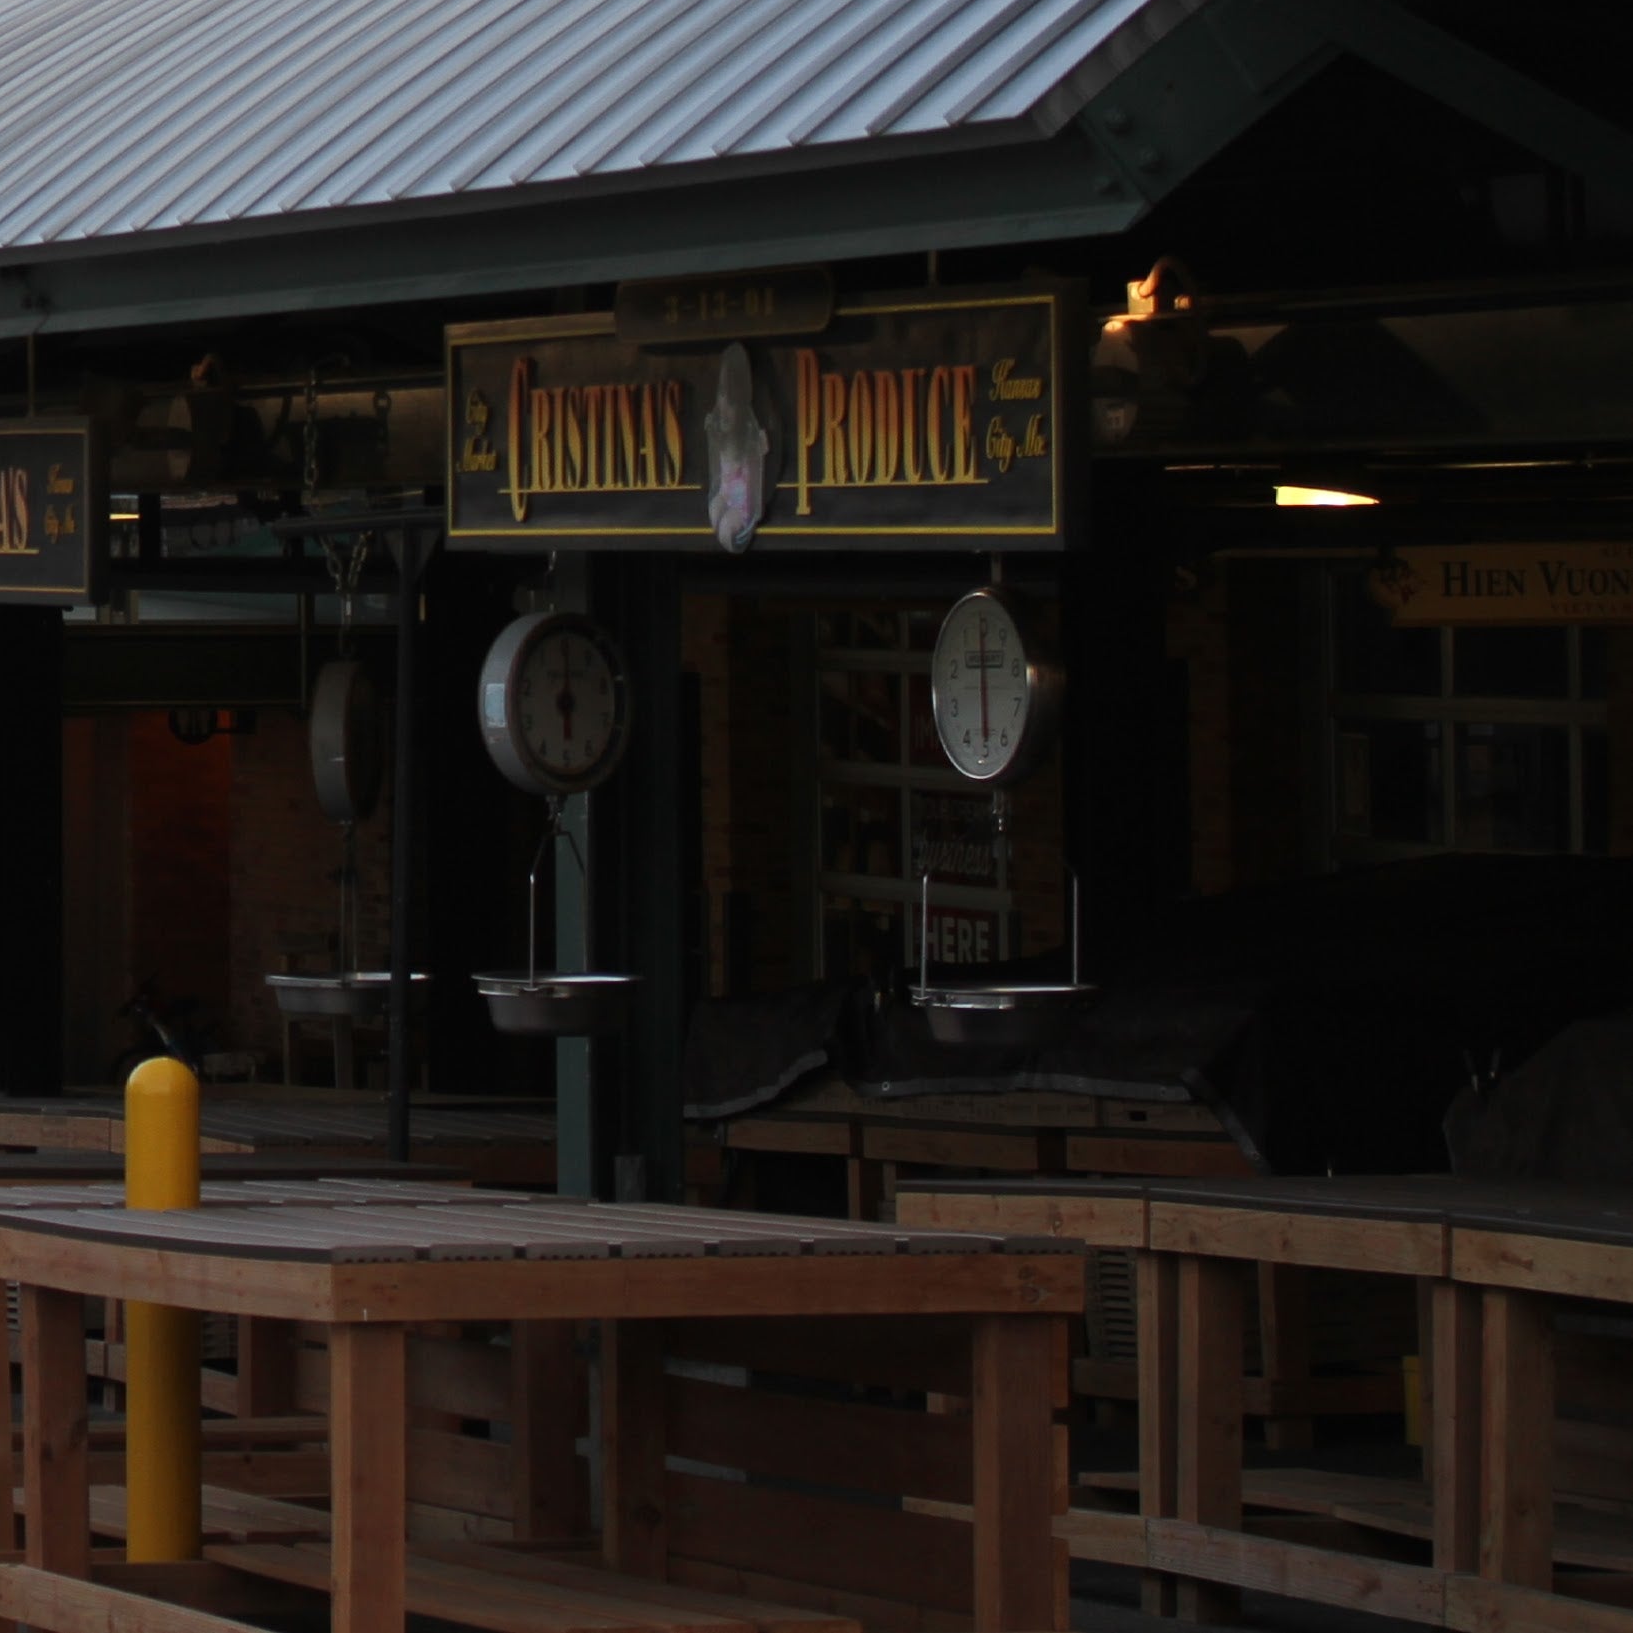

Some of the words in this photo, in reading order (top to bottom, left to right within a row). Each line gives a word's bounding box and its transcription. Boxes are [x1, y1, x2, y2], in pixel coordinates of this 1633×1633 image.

[989, 358, 1043, 402] Kansas
[795, 348, 978, 516] PRODUCE
[985, 415, 1016, 474] City
[1441, 561, 1525, 597] HIEN
[924, 916, 990, 964] HERE
